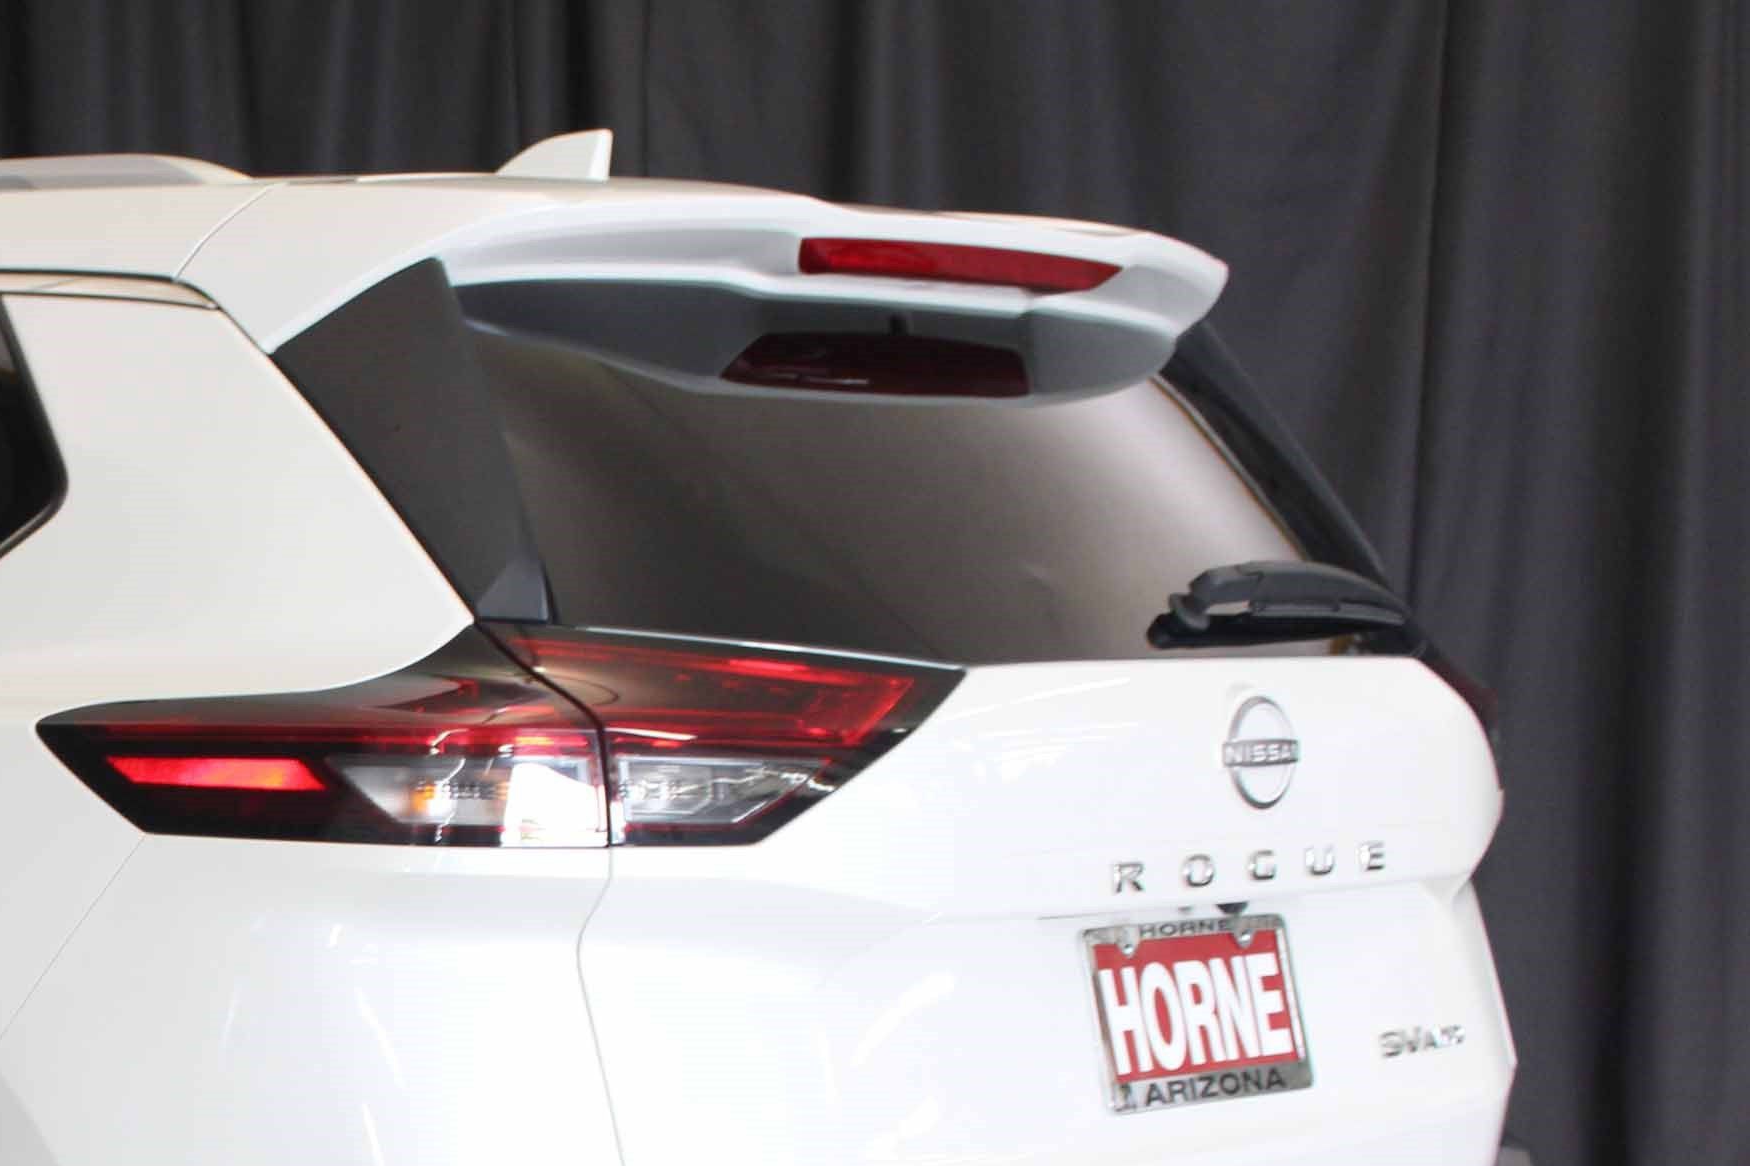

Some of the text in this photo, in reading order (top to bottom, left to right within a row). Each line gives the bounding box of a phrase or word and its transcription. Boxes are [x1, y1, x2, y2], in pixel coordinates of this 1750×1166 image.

[1111, 840, 1386, 893] ROGUE
[1139, 918, 1229, 938] HORNE
[1098, 952, 1294, 1076] HORNE
[1145, 1067, 1287, 1107] ARIZONA
